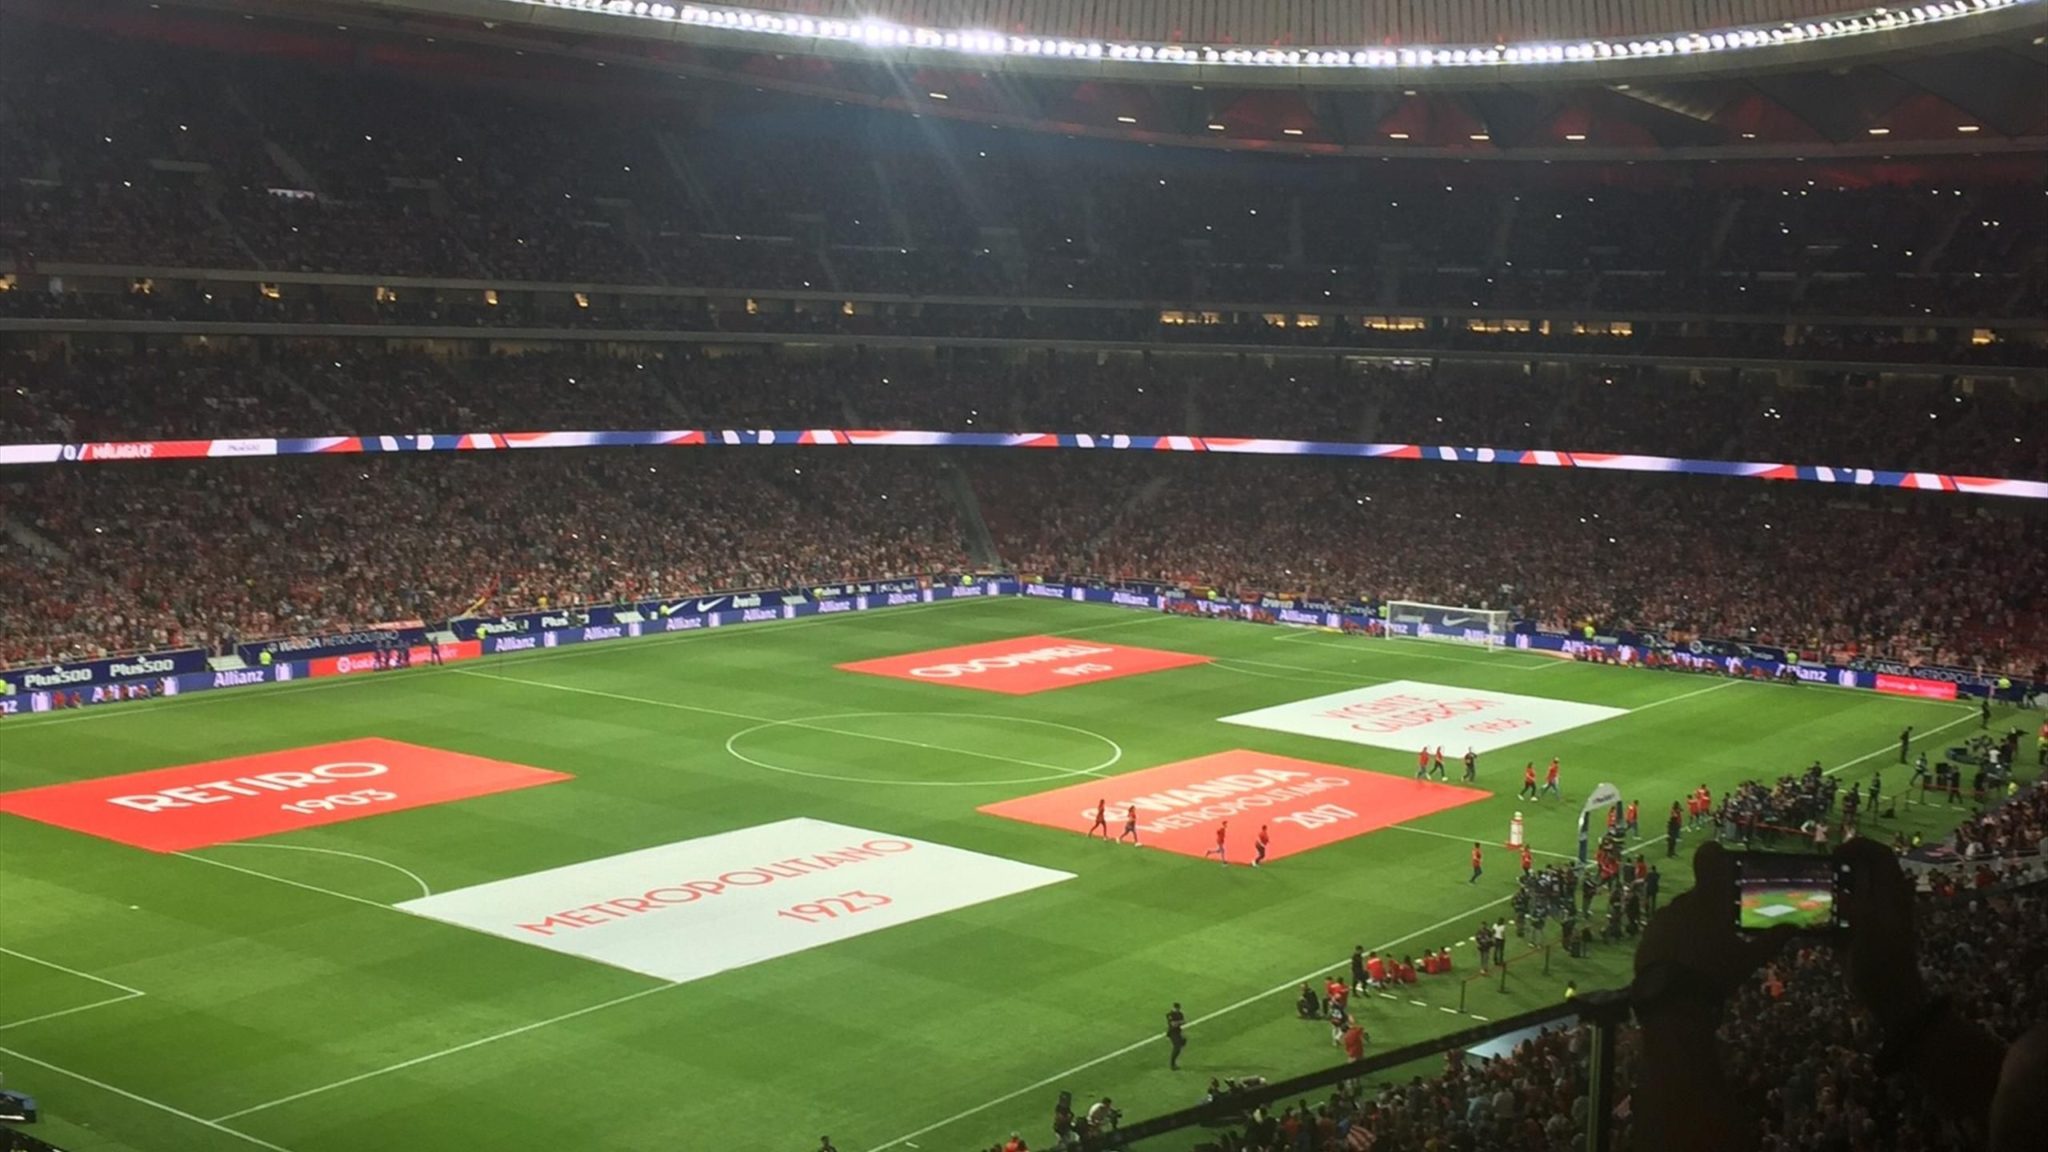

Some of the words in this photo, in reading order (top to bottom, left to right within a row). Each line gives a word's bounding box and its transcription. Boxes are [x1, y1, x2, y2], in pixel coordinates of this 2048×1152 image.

[1026, 583, 1064, 598] Allianz
[25, 667, 92, 688] Plus500
[110, 659, 174, 678] Plus500
[213, 669, 264, 687] Allianz
[106, 762, 389, 812] RETIRO
[281, 789, 398, 814] 1903
[1129, 769, 1312, 812] WANDA
[1137, 776, 1351, 834] METROPOLITANO
[1272, 803, 1359, 830] 2017
[513, 839, 913, 936] METROPOLITANO
[778, 890, 893, 923] 1923
